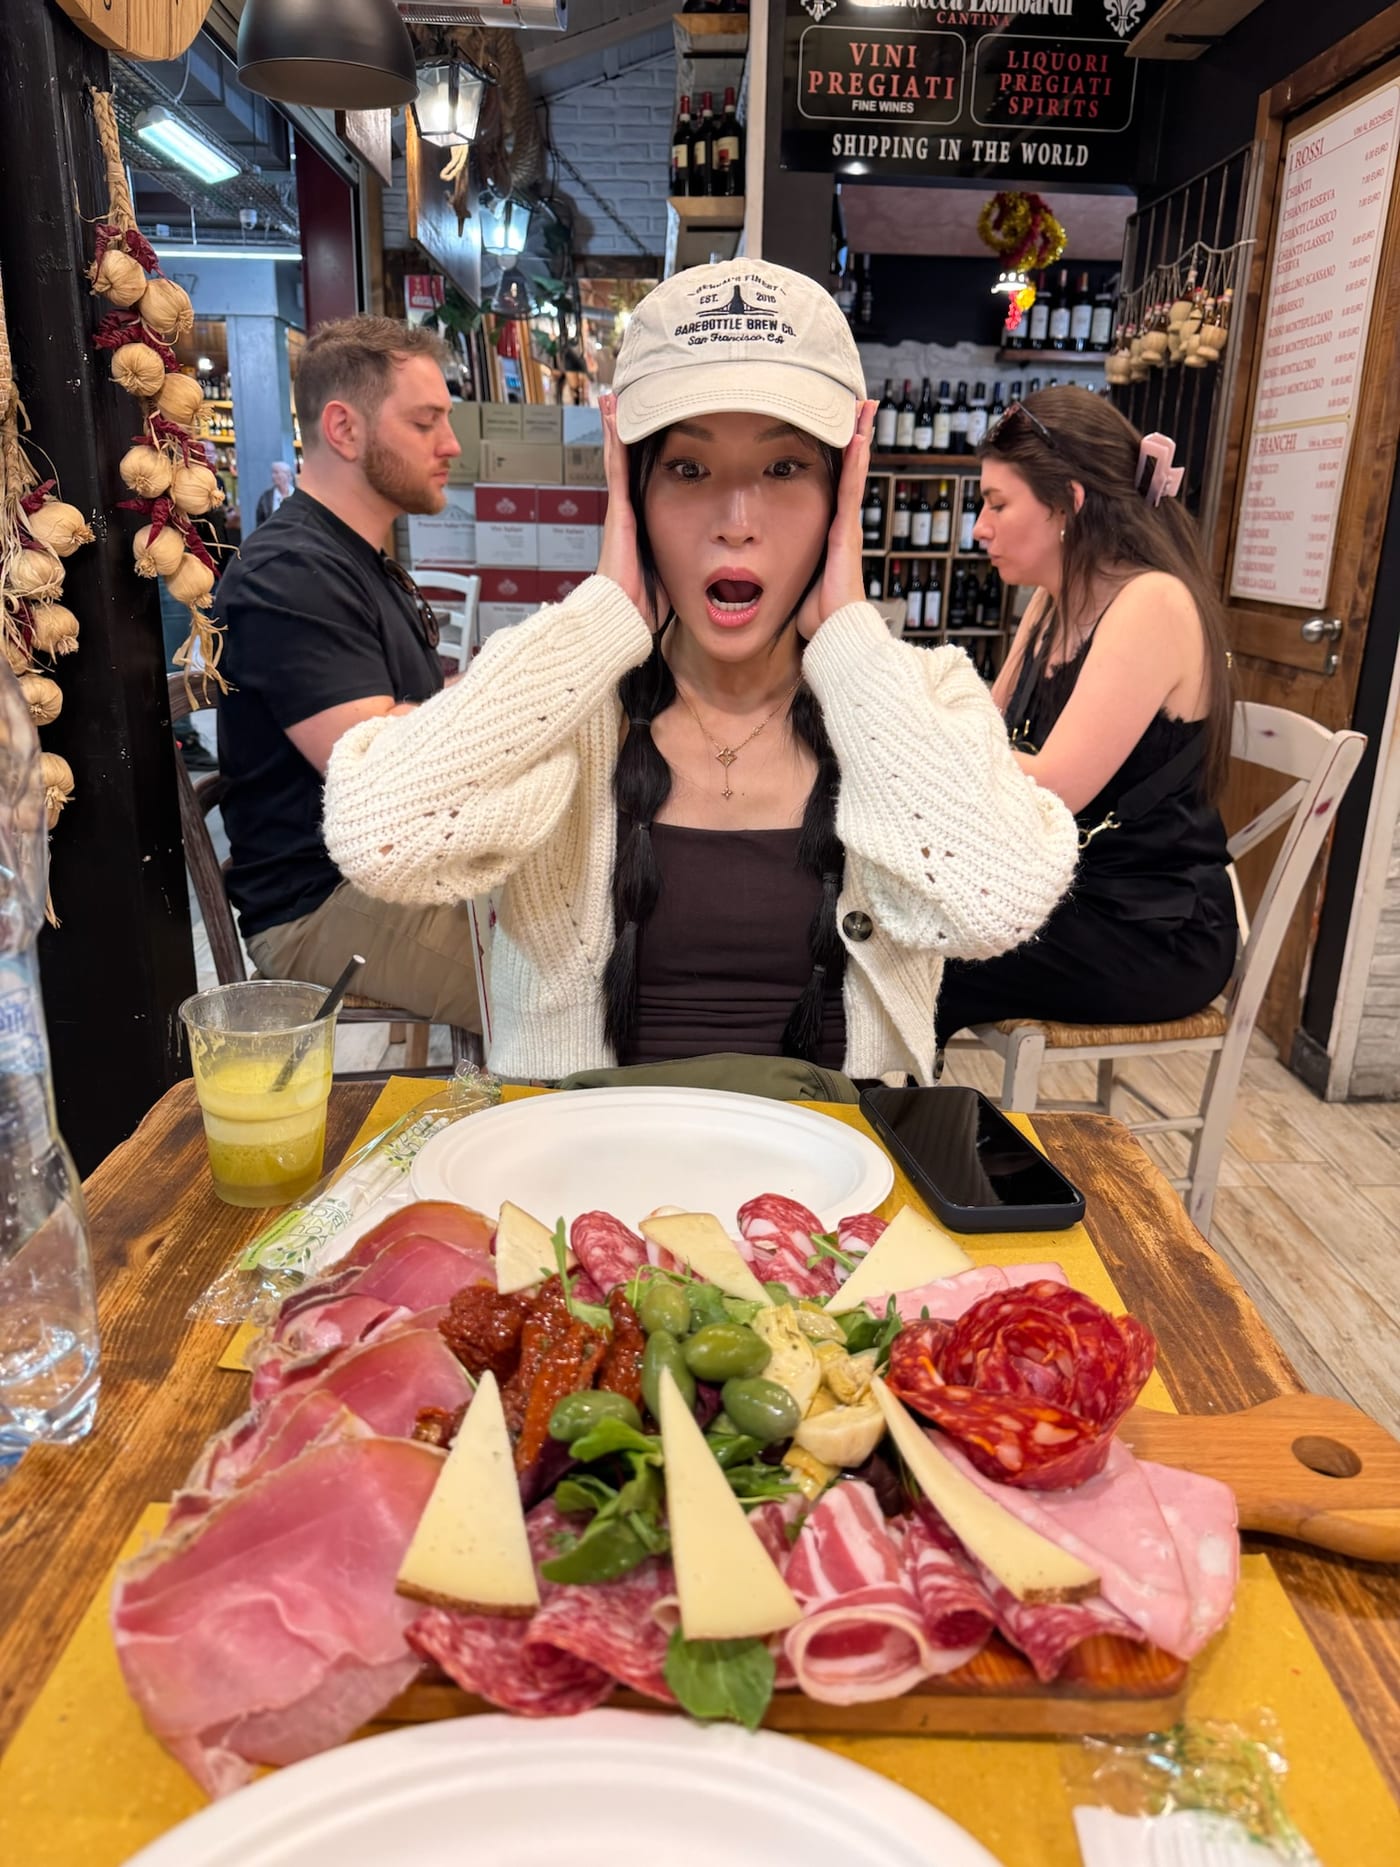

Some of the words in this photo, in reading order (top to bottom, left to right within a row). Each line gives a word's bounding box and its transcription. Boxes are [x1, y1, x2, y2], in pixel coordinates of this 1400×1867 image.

[936, 11, 1010, 26] CANTINA
[849, 42, 917, 68] VINI
[1007, 50, 1109, 75] LIQUORI
[807, 70, 955, 100] PREGIATI
[999, 73, 1112, 96] PREGIATI
[852, 99, 877, 112] FINE
[879, 100, 914, 113] WINES
[1008, 96, 1099, 118] SPIRITS
[832, 133, 929, 160] SHIPPING
[938, 138, 962, 161] IN
[972, 140, 1010, 163] THE
[1021, 142, 1089, 166] WORLD
[1289, 154, 1293, 171] I
[1295, 137, 1324, 168] ROSSI
[1286, 179, 1311, 200] CHIANTI
[1283, 201, 1308, 221] CHIANTI
[1309, 188, 1336, 209] RISERVA
[1280, 223, 1305, 242] CHIANTI
[1307, 209, 1336, 231] CLASSICO
[1278, 244, 1302, 262] CHIANTI
[1304, 230, 1333, 251] CLASSICO
[699, 293, 719, 305] EST.
[674, 318, 742, 337] BAREBOTTLE
[746, 319, 778, 331] BREW
[781, 323, 797, 337] CO.
[687, 335, 709, 346] San
[710, 333, 765, 343] Francisco,
[1259, 433, 1297, 453] BIANCHI
